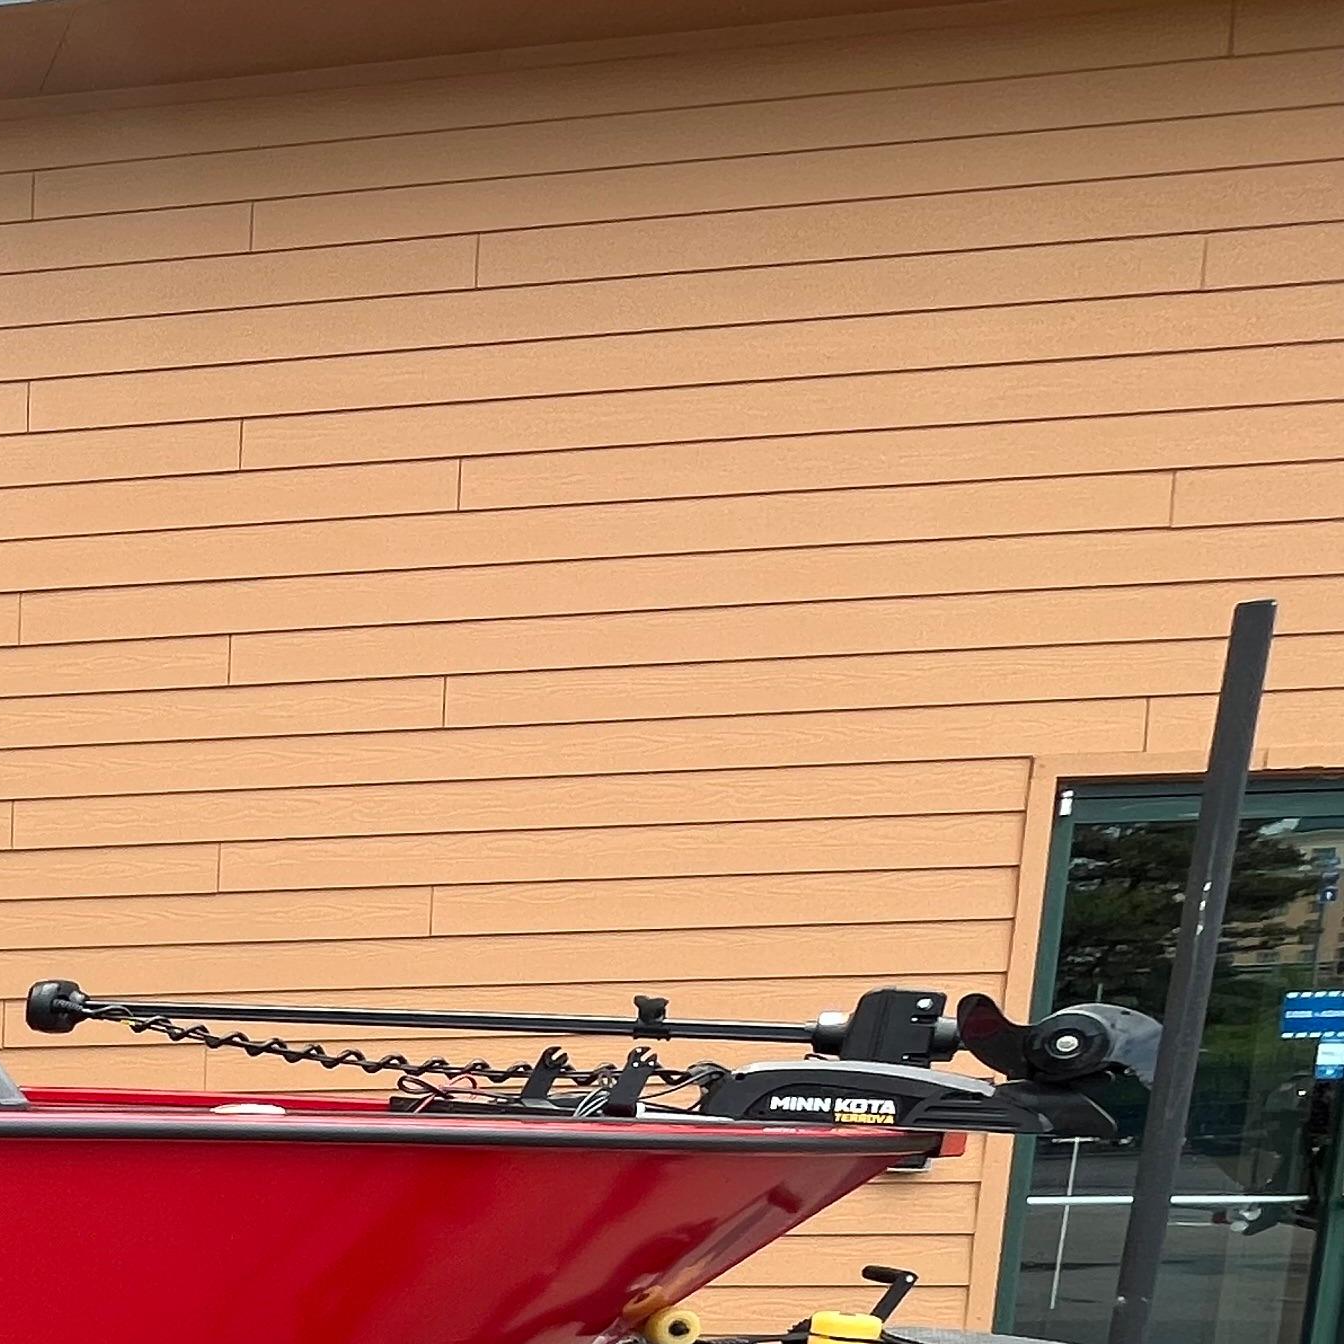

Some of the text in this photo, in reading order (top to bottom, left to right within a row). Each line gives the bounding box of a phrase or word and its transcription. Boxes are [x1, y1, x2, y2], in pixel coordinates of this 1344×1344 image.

[769, 1096, 896, 1114] MINN KOTA
[834, 1113, 895, 1124] TERROVA
